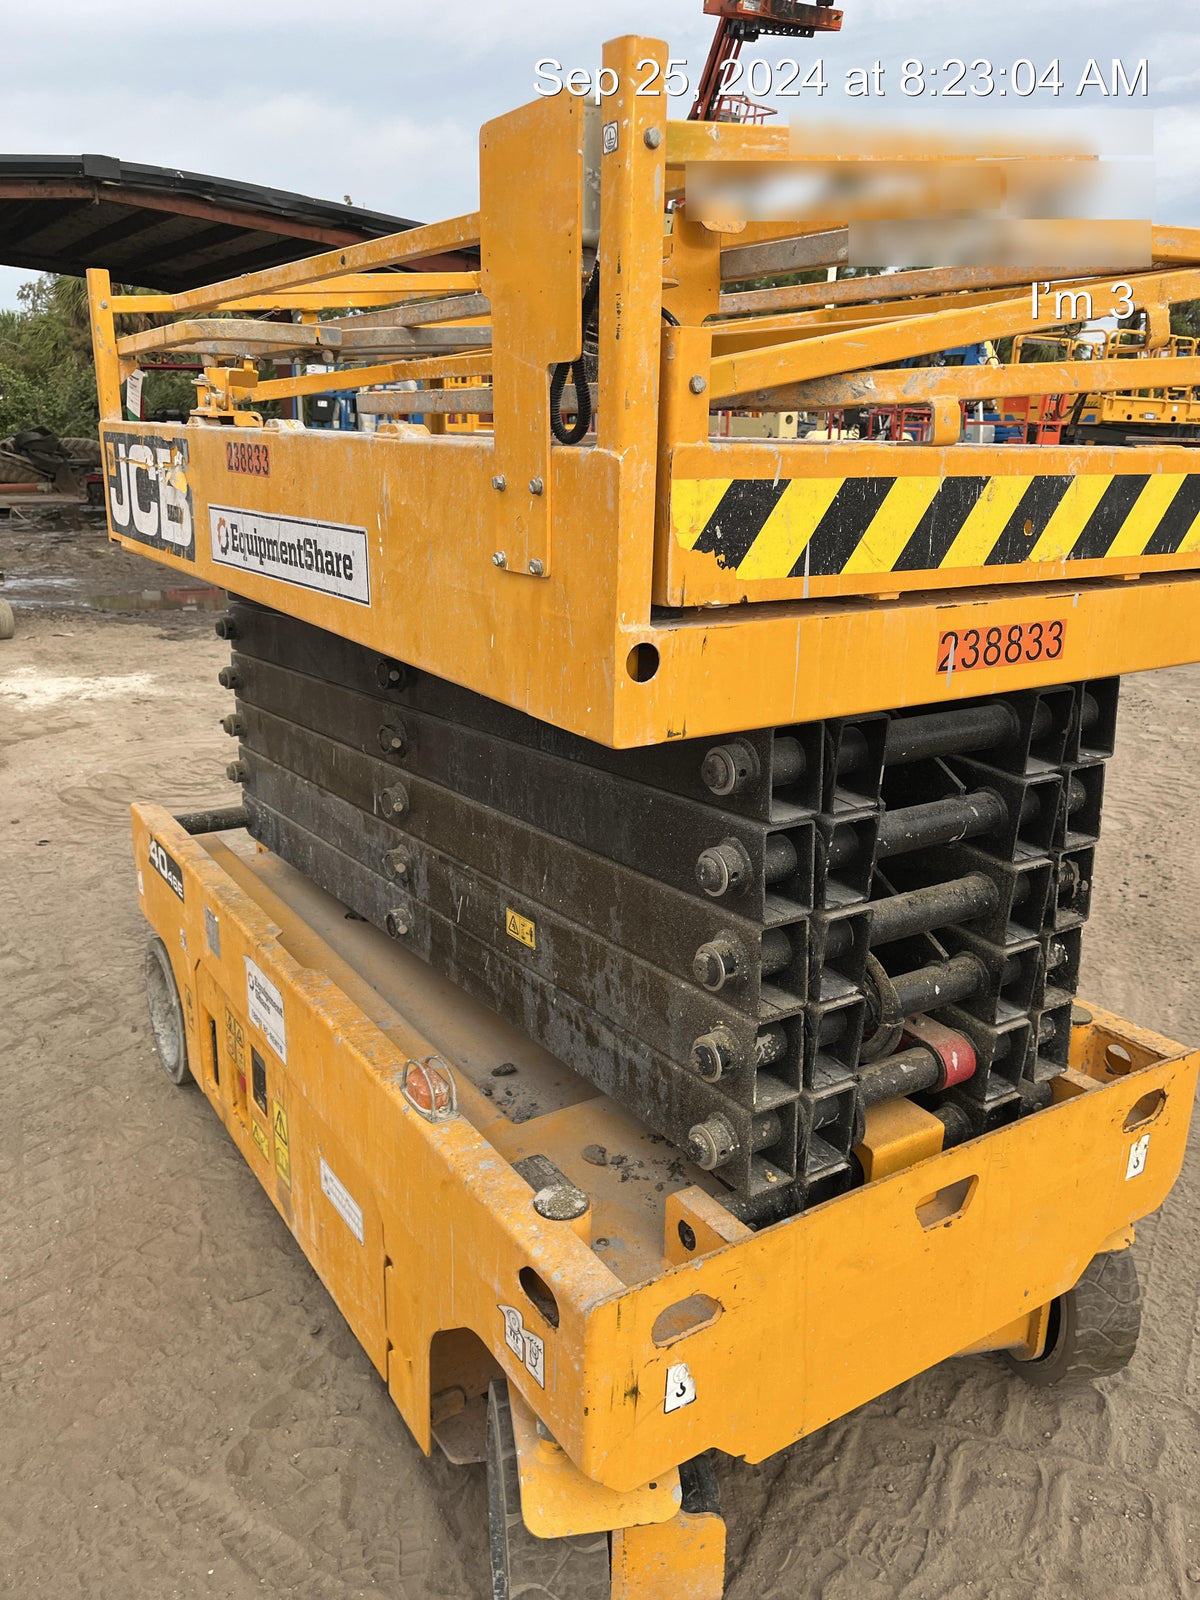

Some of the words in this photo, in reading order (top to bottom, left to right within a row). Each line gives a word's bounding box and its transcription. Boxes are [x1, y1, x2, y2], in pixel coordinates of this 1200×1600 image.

[227, 442, 269, 476] 238833
[110, 444, 191, 547] JCB
[230, 523, 354, 581] EquipmentShare
[937, 620, 1063, 672] 238833
